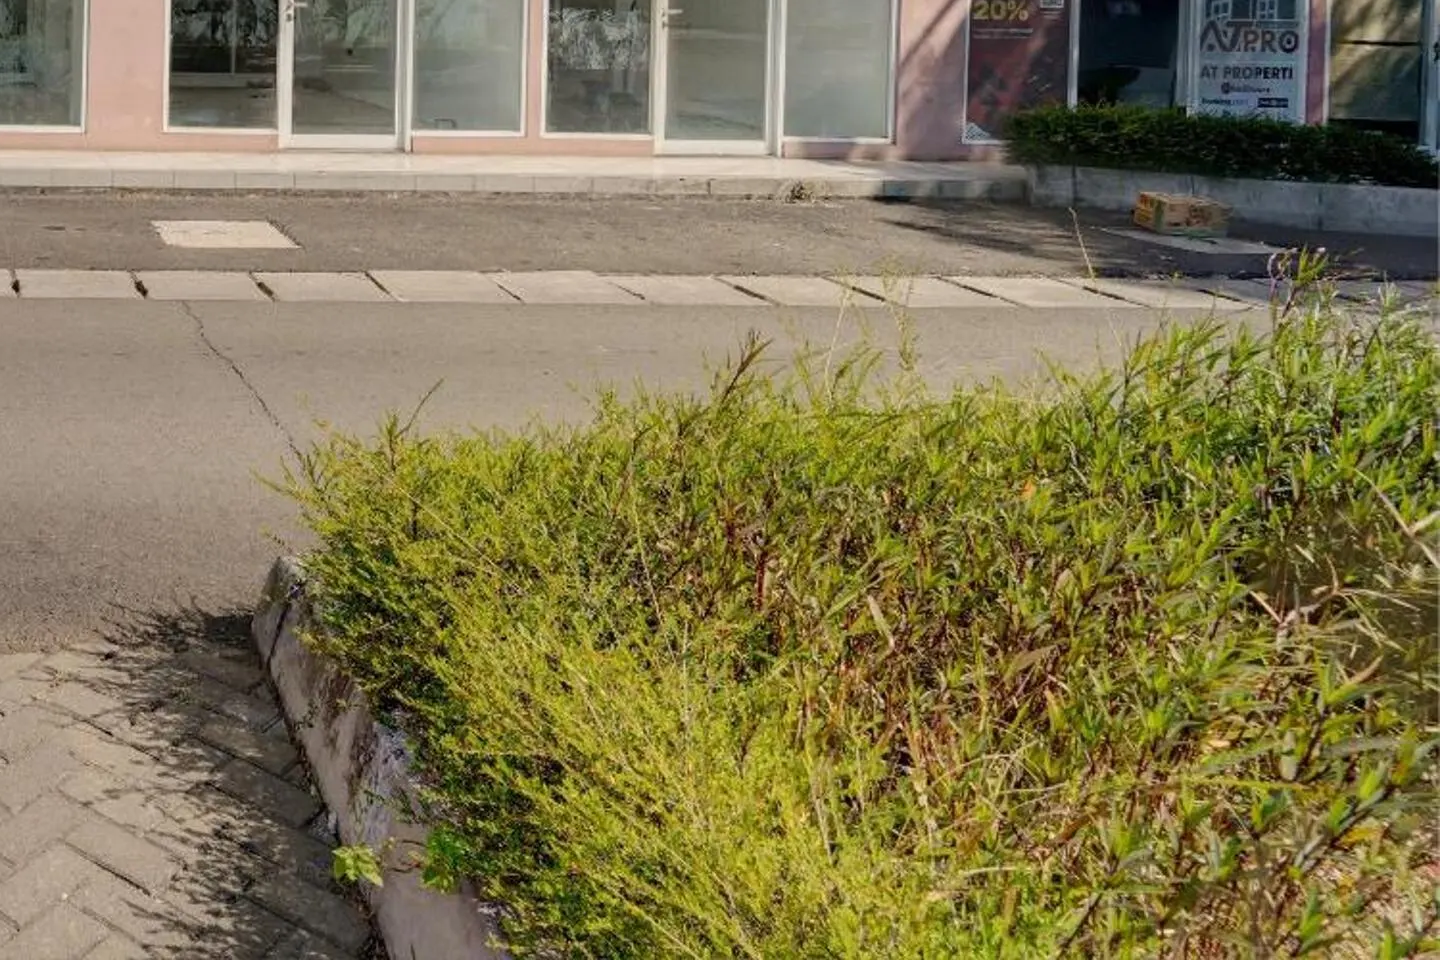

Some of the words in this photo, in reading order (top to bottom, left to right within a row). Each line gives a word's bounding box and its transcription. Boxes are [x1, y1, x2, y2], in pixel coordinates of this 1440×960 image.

[973, 0, 1029, 21] 20%
[1201, 66, 1218, 79] AT
[1223, 66, 1293, 80] PROPERTI
